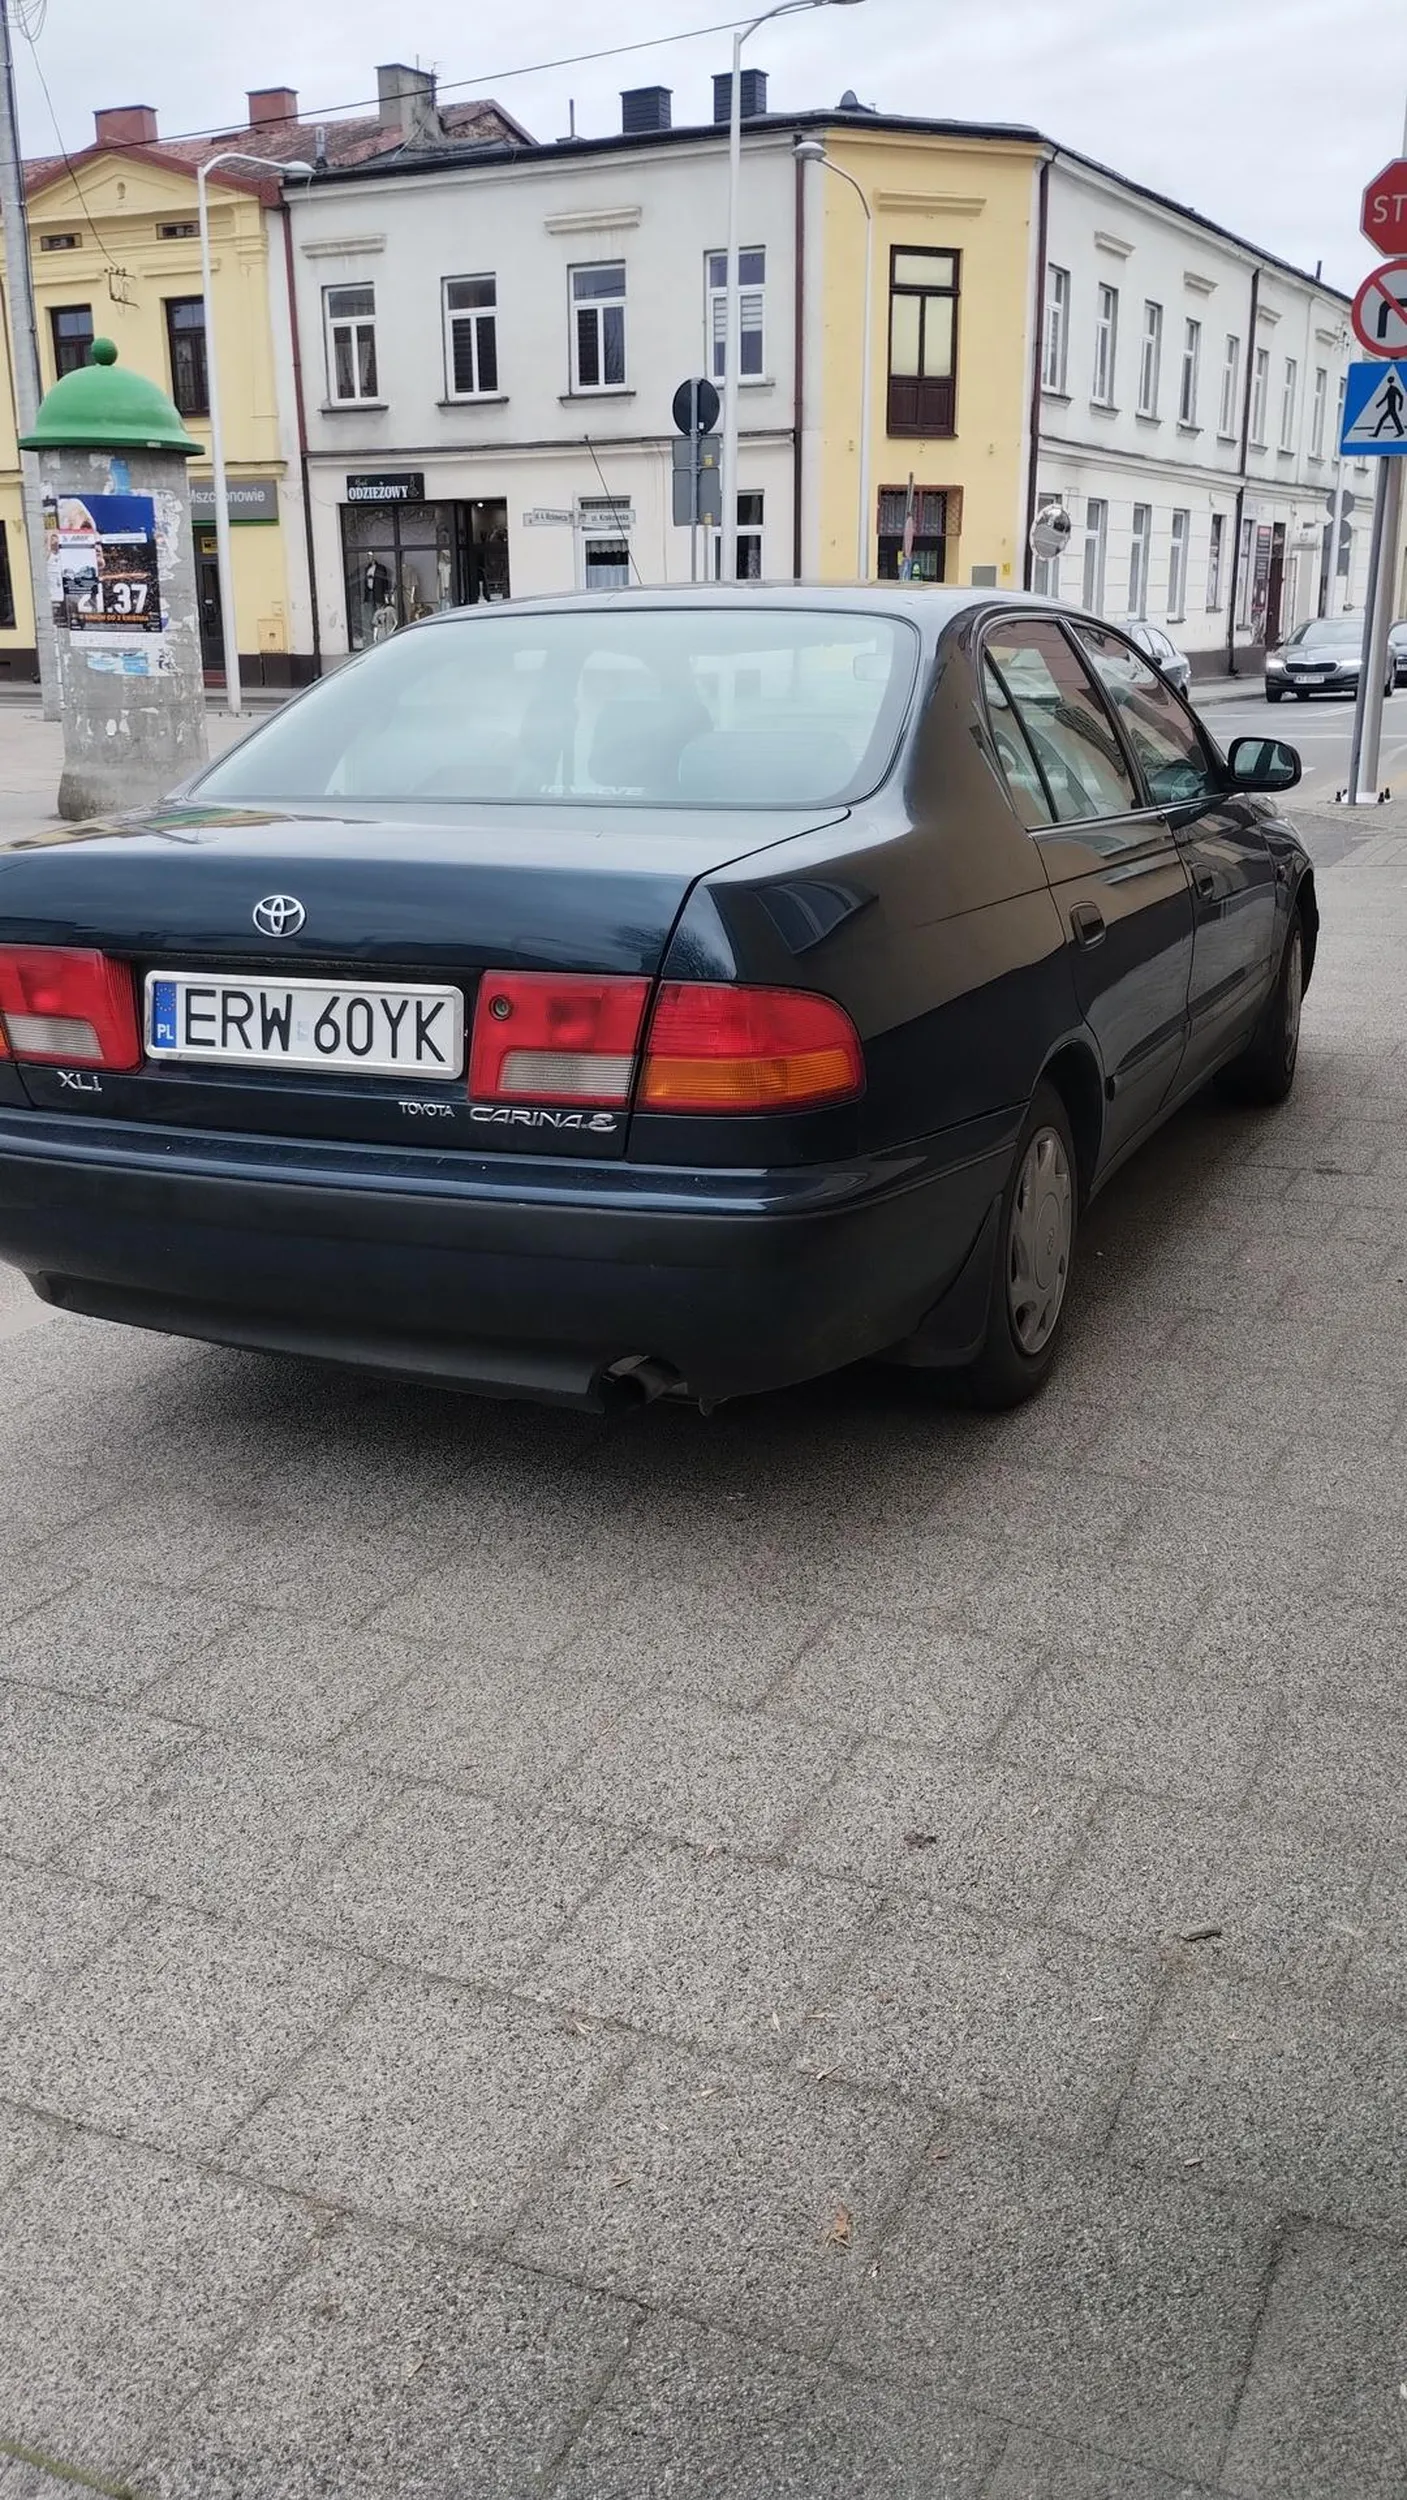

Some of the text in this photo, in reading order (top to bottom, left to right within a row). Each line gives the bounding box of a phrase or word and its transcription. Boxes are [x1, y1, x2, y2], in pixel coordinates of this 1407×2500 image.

[77, 582, 148, 614] 21.37
[157, 1023, 174, 1041] PL
[184, 987, 446, 1063] ERW 60YK
[398, 1101, 456, 1118] TOYOTA
